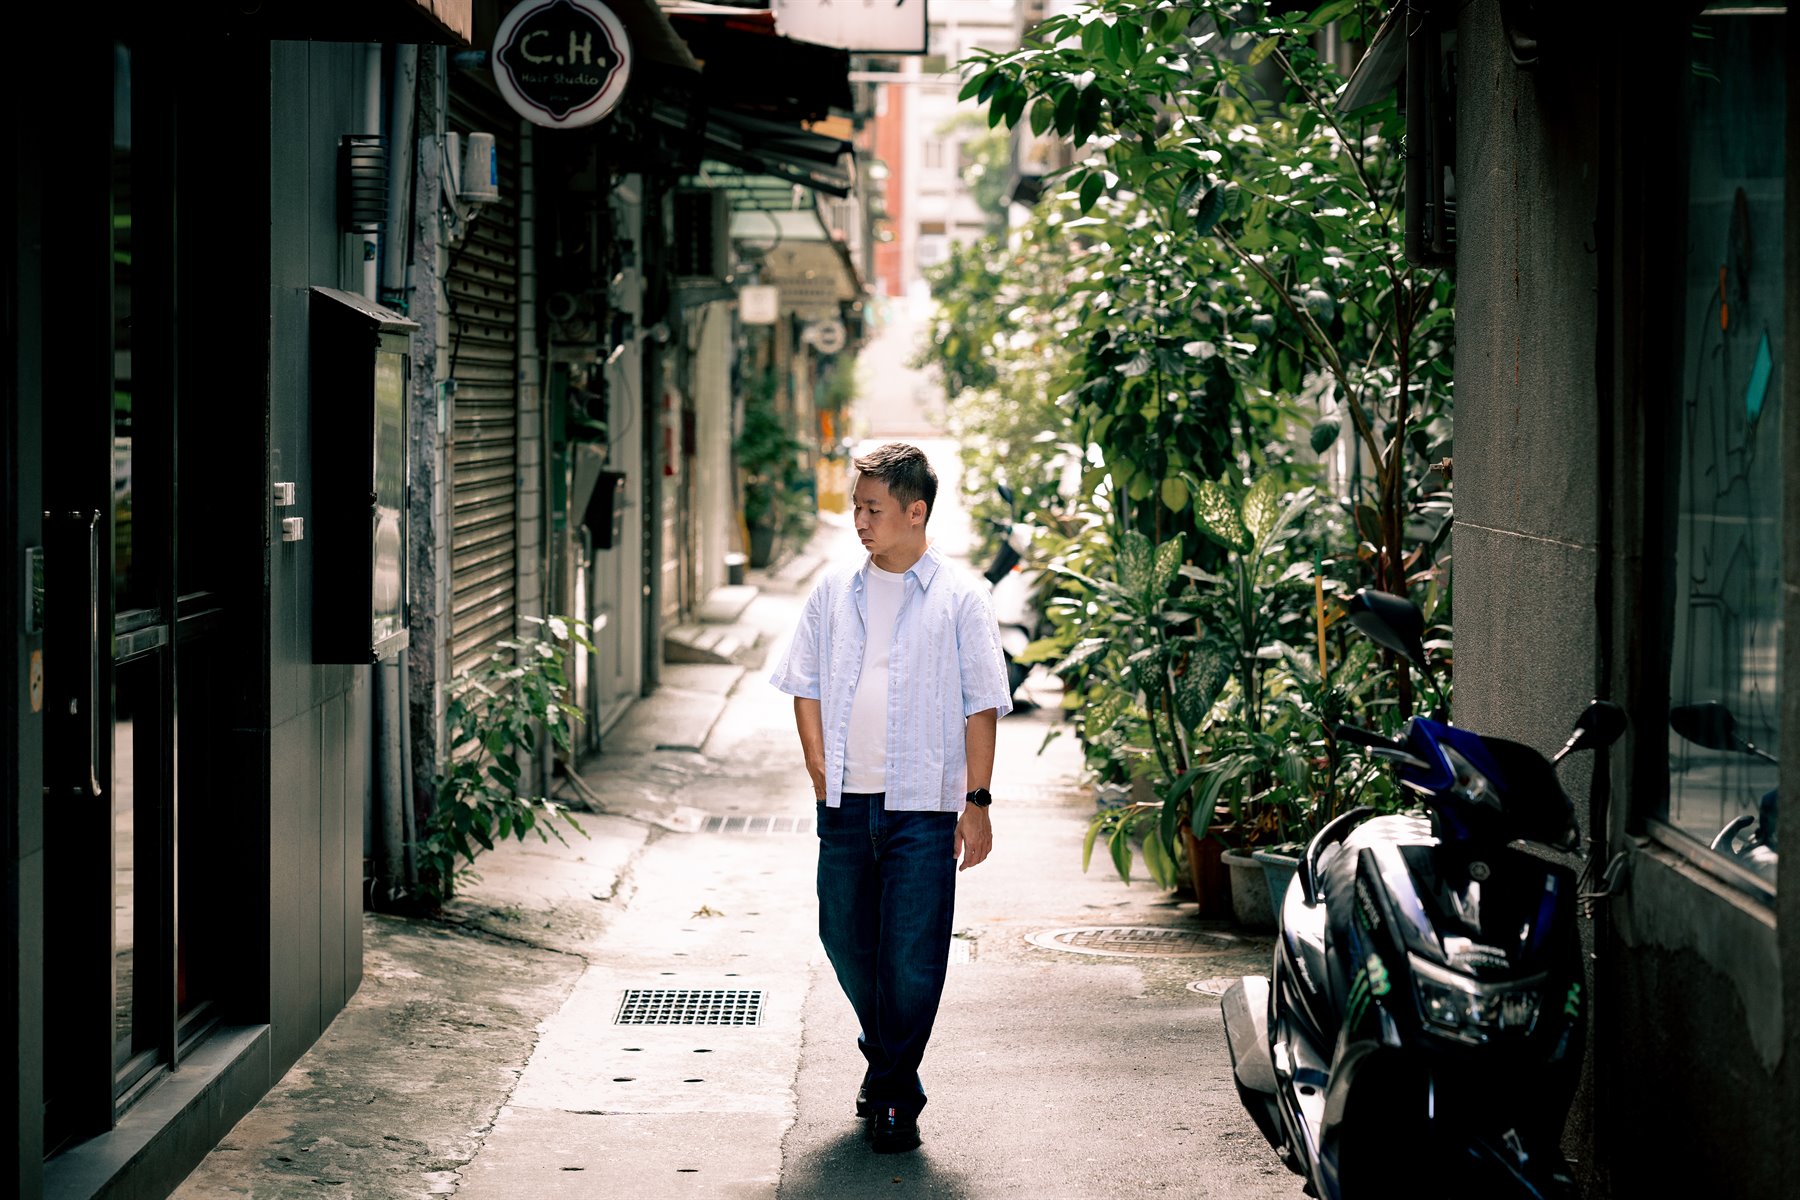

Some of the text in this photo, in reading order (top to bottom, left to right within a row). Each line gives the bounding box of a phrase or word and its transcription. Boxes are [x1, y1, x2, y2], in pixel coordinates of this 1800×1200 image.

[520, 30, 606, 67] C.H.
[521, 73, 600, 86] Hair Studio
